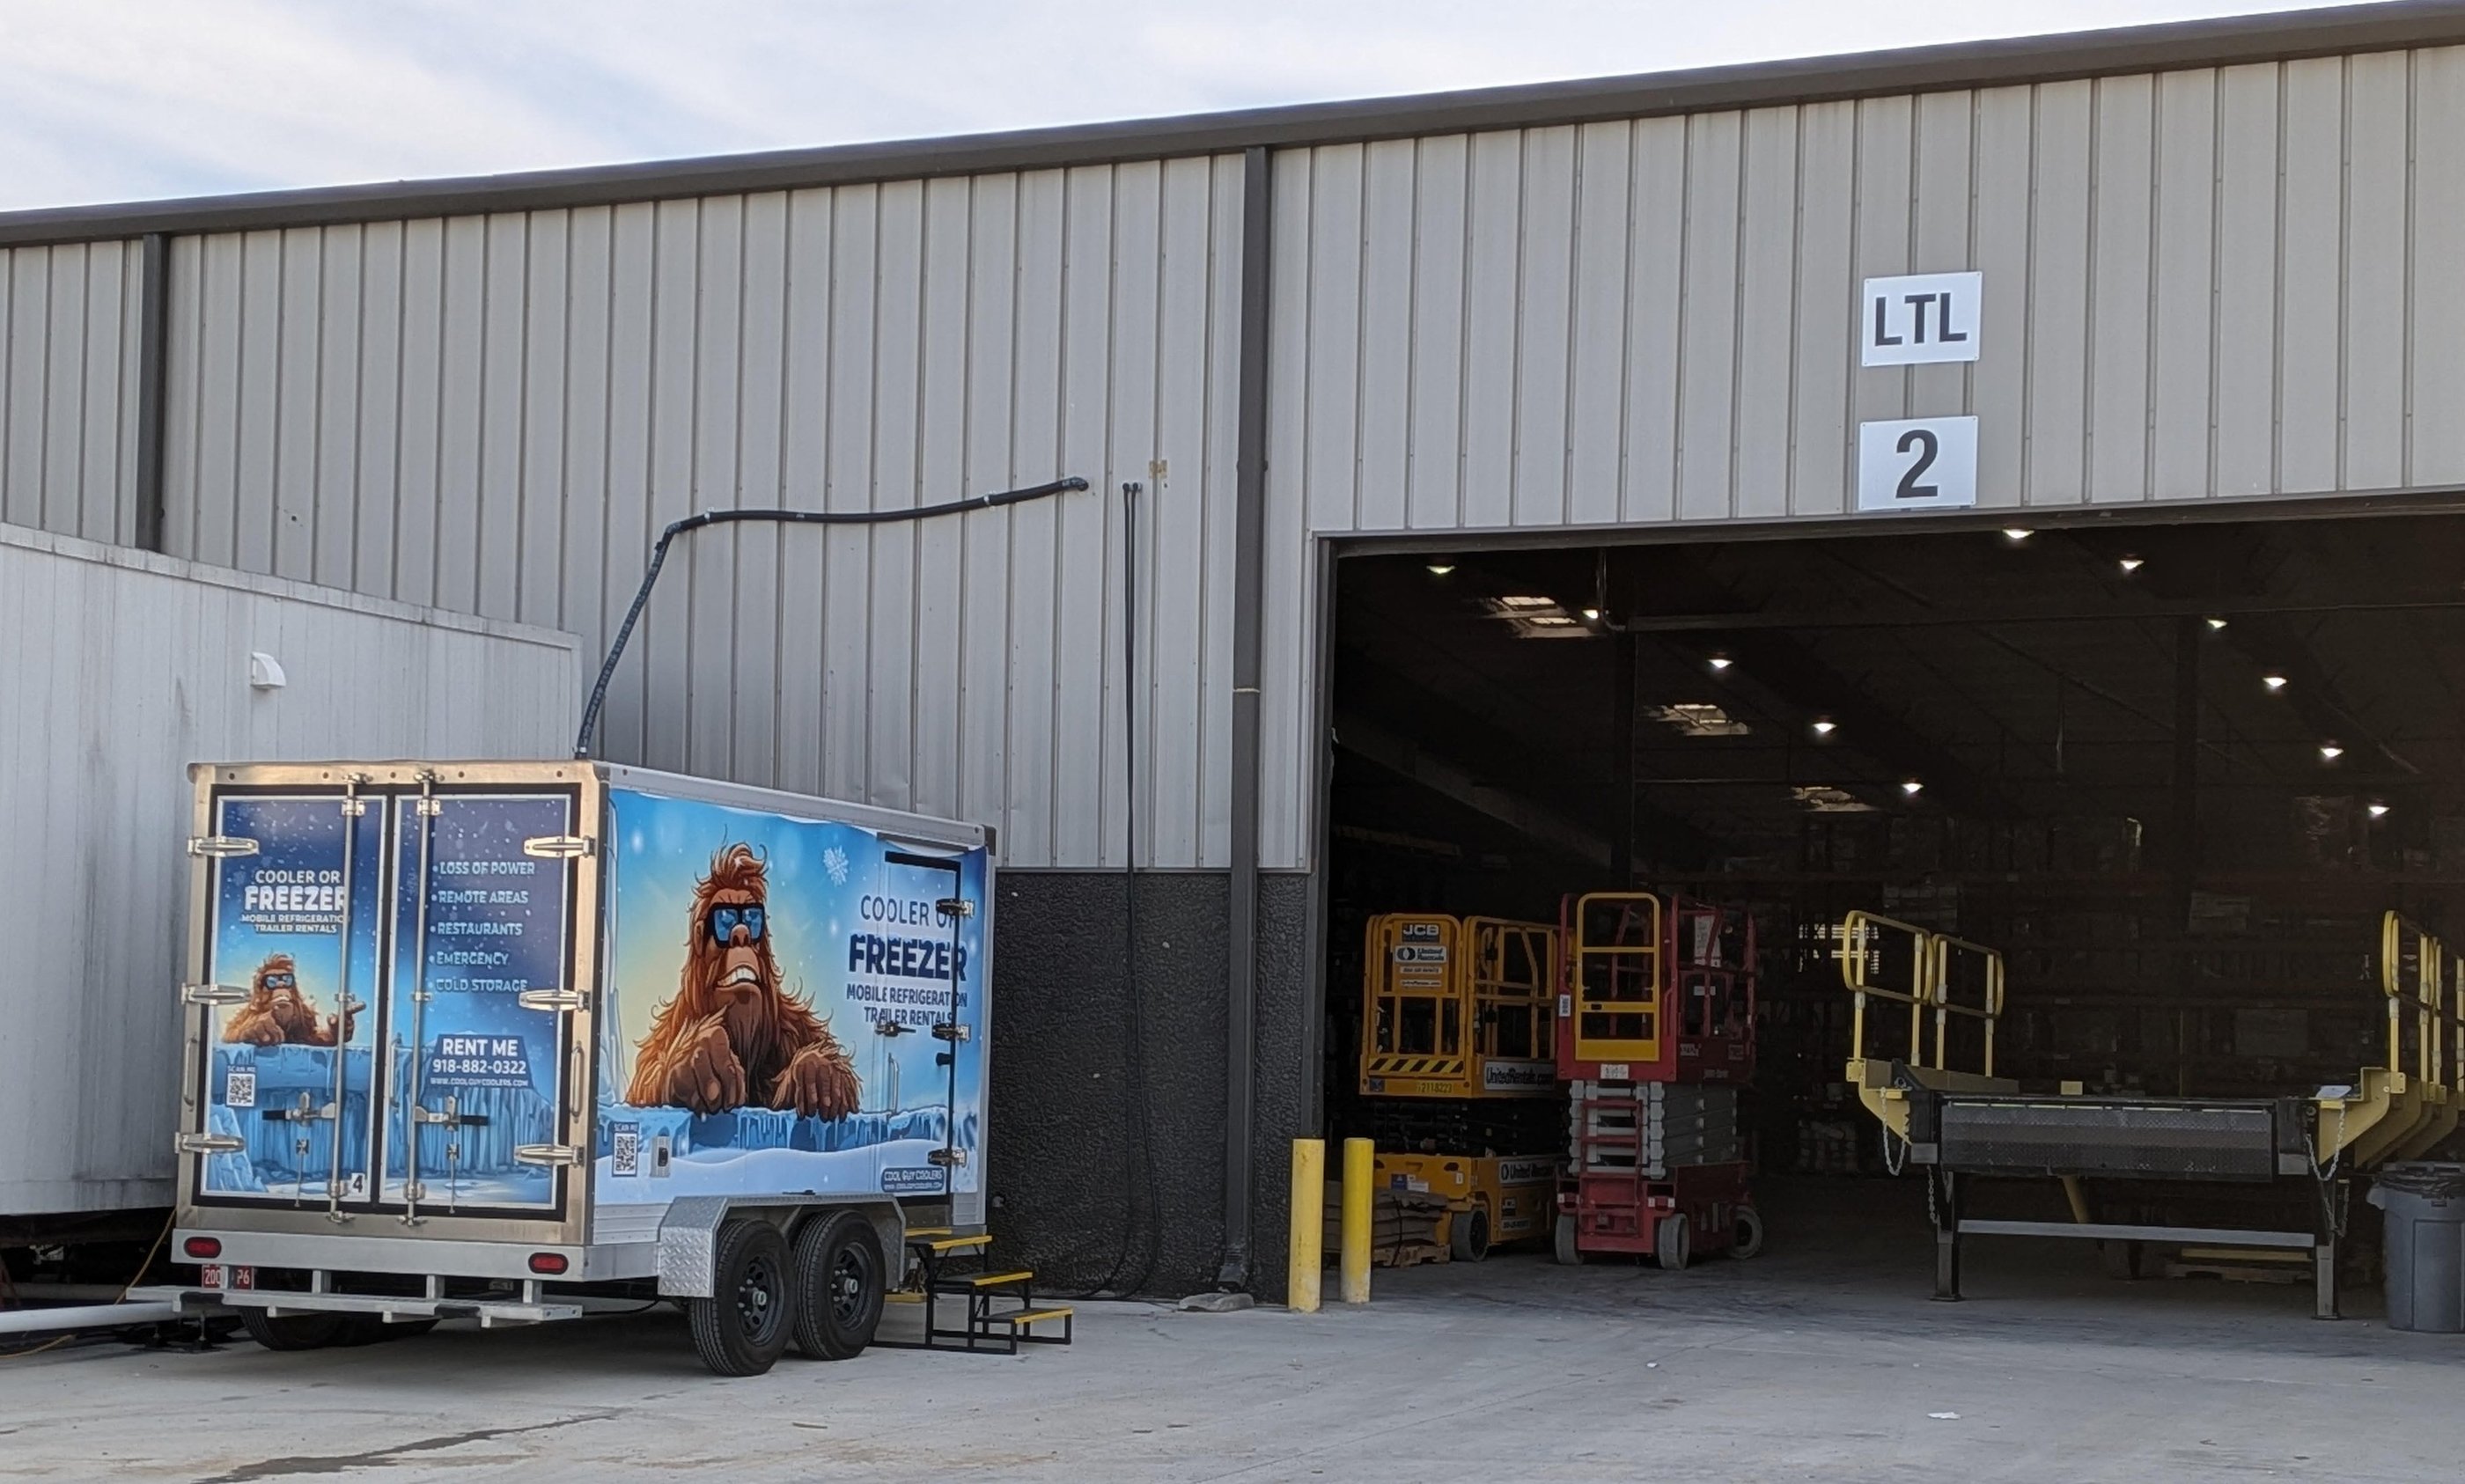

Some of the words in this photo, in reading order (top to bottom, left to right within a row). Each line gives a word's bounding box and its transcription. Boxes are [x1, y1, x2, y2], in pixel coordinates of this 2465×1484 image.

[1874, 292, 1968, 346] LTL
[1895, 430, 1939, 498] 2
[440, 862, 469, 875] LOSS
[472, 862, 489, 875] OF
[490, 862, 535, 875] POWER
[255, 870, 315, 884] COOLER
[319, 870, 341, 884] OR
[245, 885, 345, 911] FREEZER
[438, 891, 488, 904] REMOTE
[489, 891, 529, 904] AREAS
[860, 894, 930, 927] COOLER
[241, 915, 276, 923] MOBILE
[278, 915, 345, 923] REFRIGERATIO
[296, 924, 337, 933] RENTALS
[438, 922, 523, 936] RESTAURANTS
[1402, 924, 1439, 936] JCB
[437, 951, 509, 966] EMERGENCY
[849, 933, 968, 981] FREEZER
[436, 978, 468, 991] COLD
[471, 979, 528, 992] STORAGE
[846, 983, 888, 1003] MOBILE
[864, 1007, 908, 1025] TRAILER
[442, 1039, 489, 1055] RENT
[491, 1040, 519, 1056] ME
[432, 1059, 526, 1074] 918-882-0322
[884, 1172, 901, 1181] COOL
[916, 1170, 943, 1180] COOLERS
[352, 1174, 364, 1194] 4
